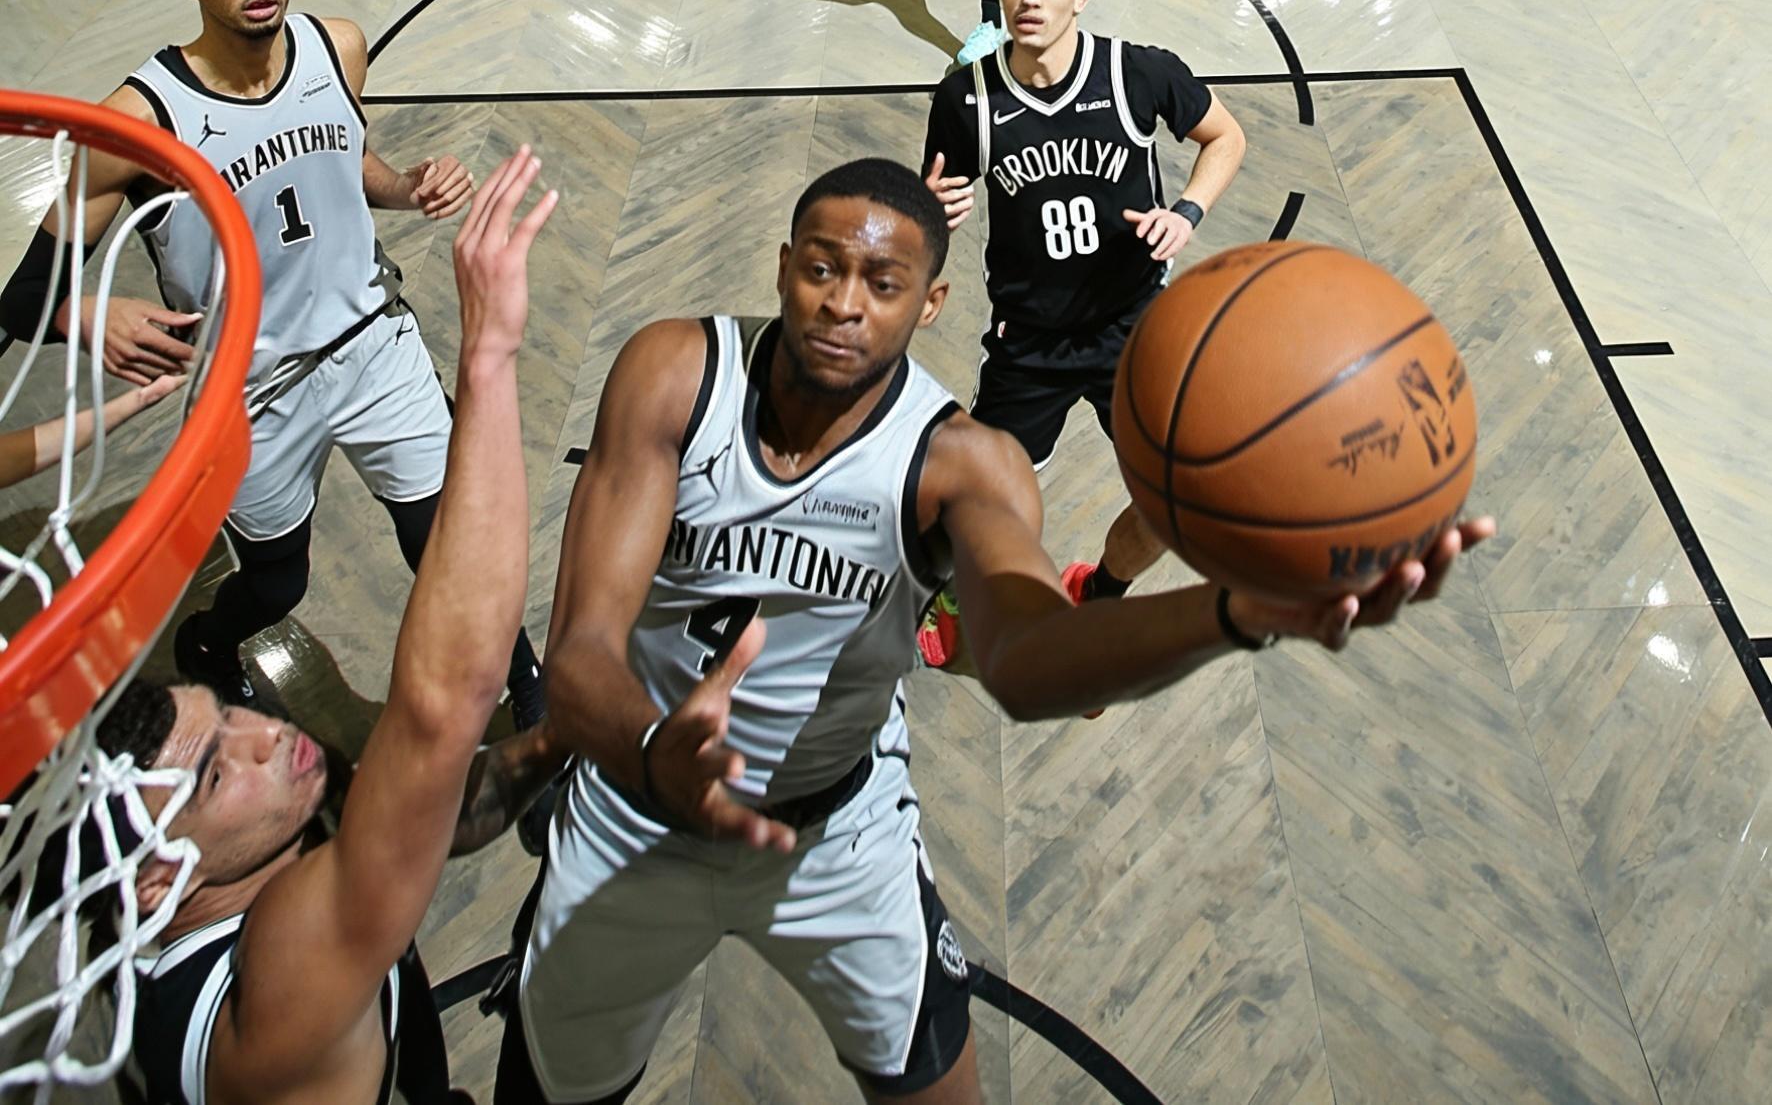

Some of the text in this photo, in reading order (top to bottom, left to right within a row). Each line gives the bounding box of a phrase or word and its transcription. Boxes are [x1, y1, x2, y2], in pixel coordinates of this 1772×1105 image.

[274, 184, 315, 247] 1
[1041, 195, 1100, 261] 88
[683, 595, 762, 673] 4
